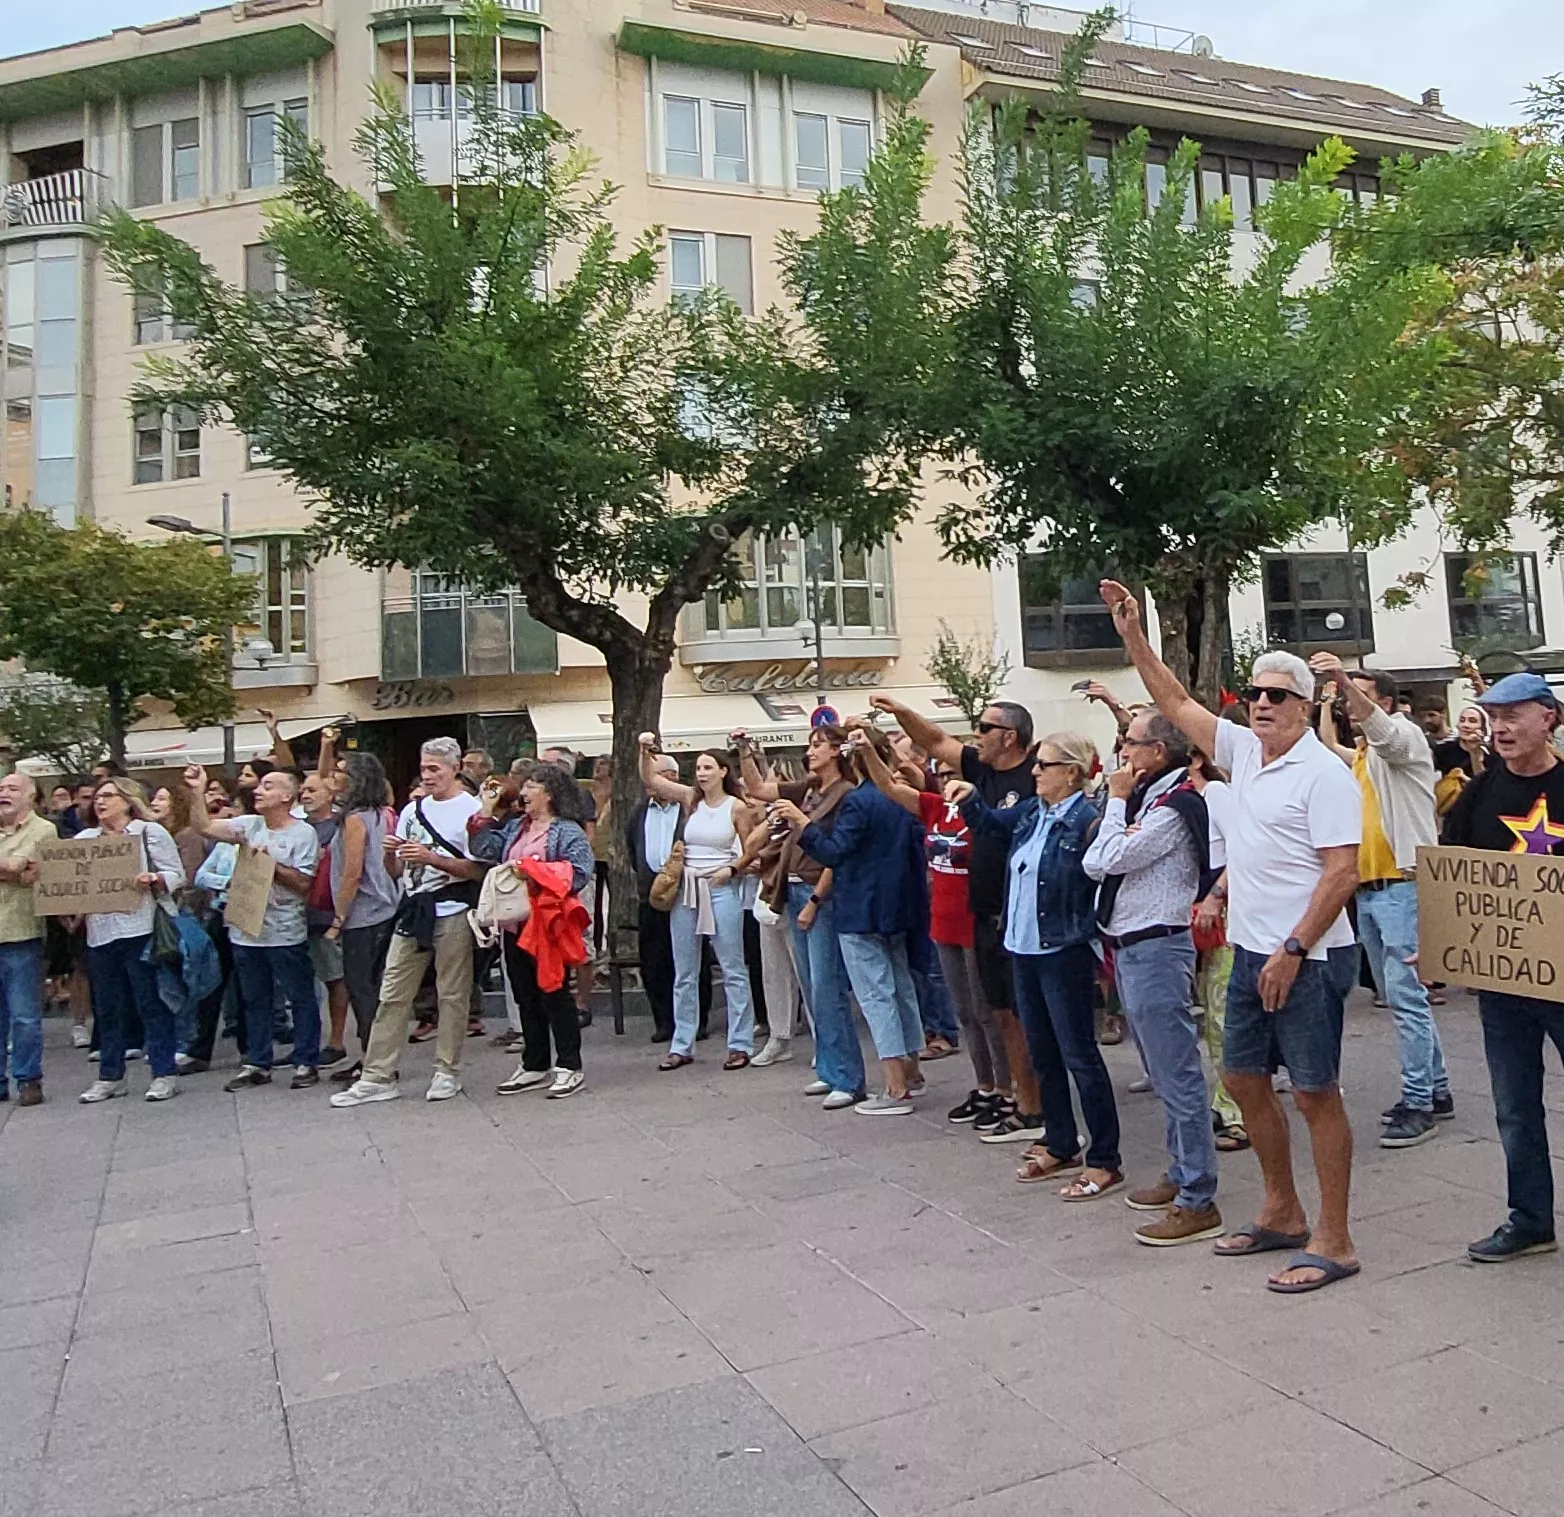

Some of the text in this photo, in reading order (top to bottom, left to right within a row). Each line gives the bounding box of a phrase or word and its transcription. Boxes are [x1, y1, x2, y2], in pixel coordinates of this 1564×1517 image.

[371, 682, 454, 711] Bar
[75, 861, 92, 875] DE
[1426, 857, 1519, 890] VIVIENDA
[1455, 890, 1544, 925] PUBLICA
[1469, 922, 1524, 949] Y DE
[1443, 946, 1556, 986] CALIDAD
